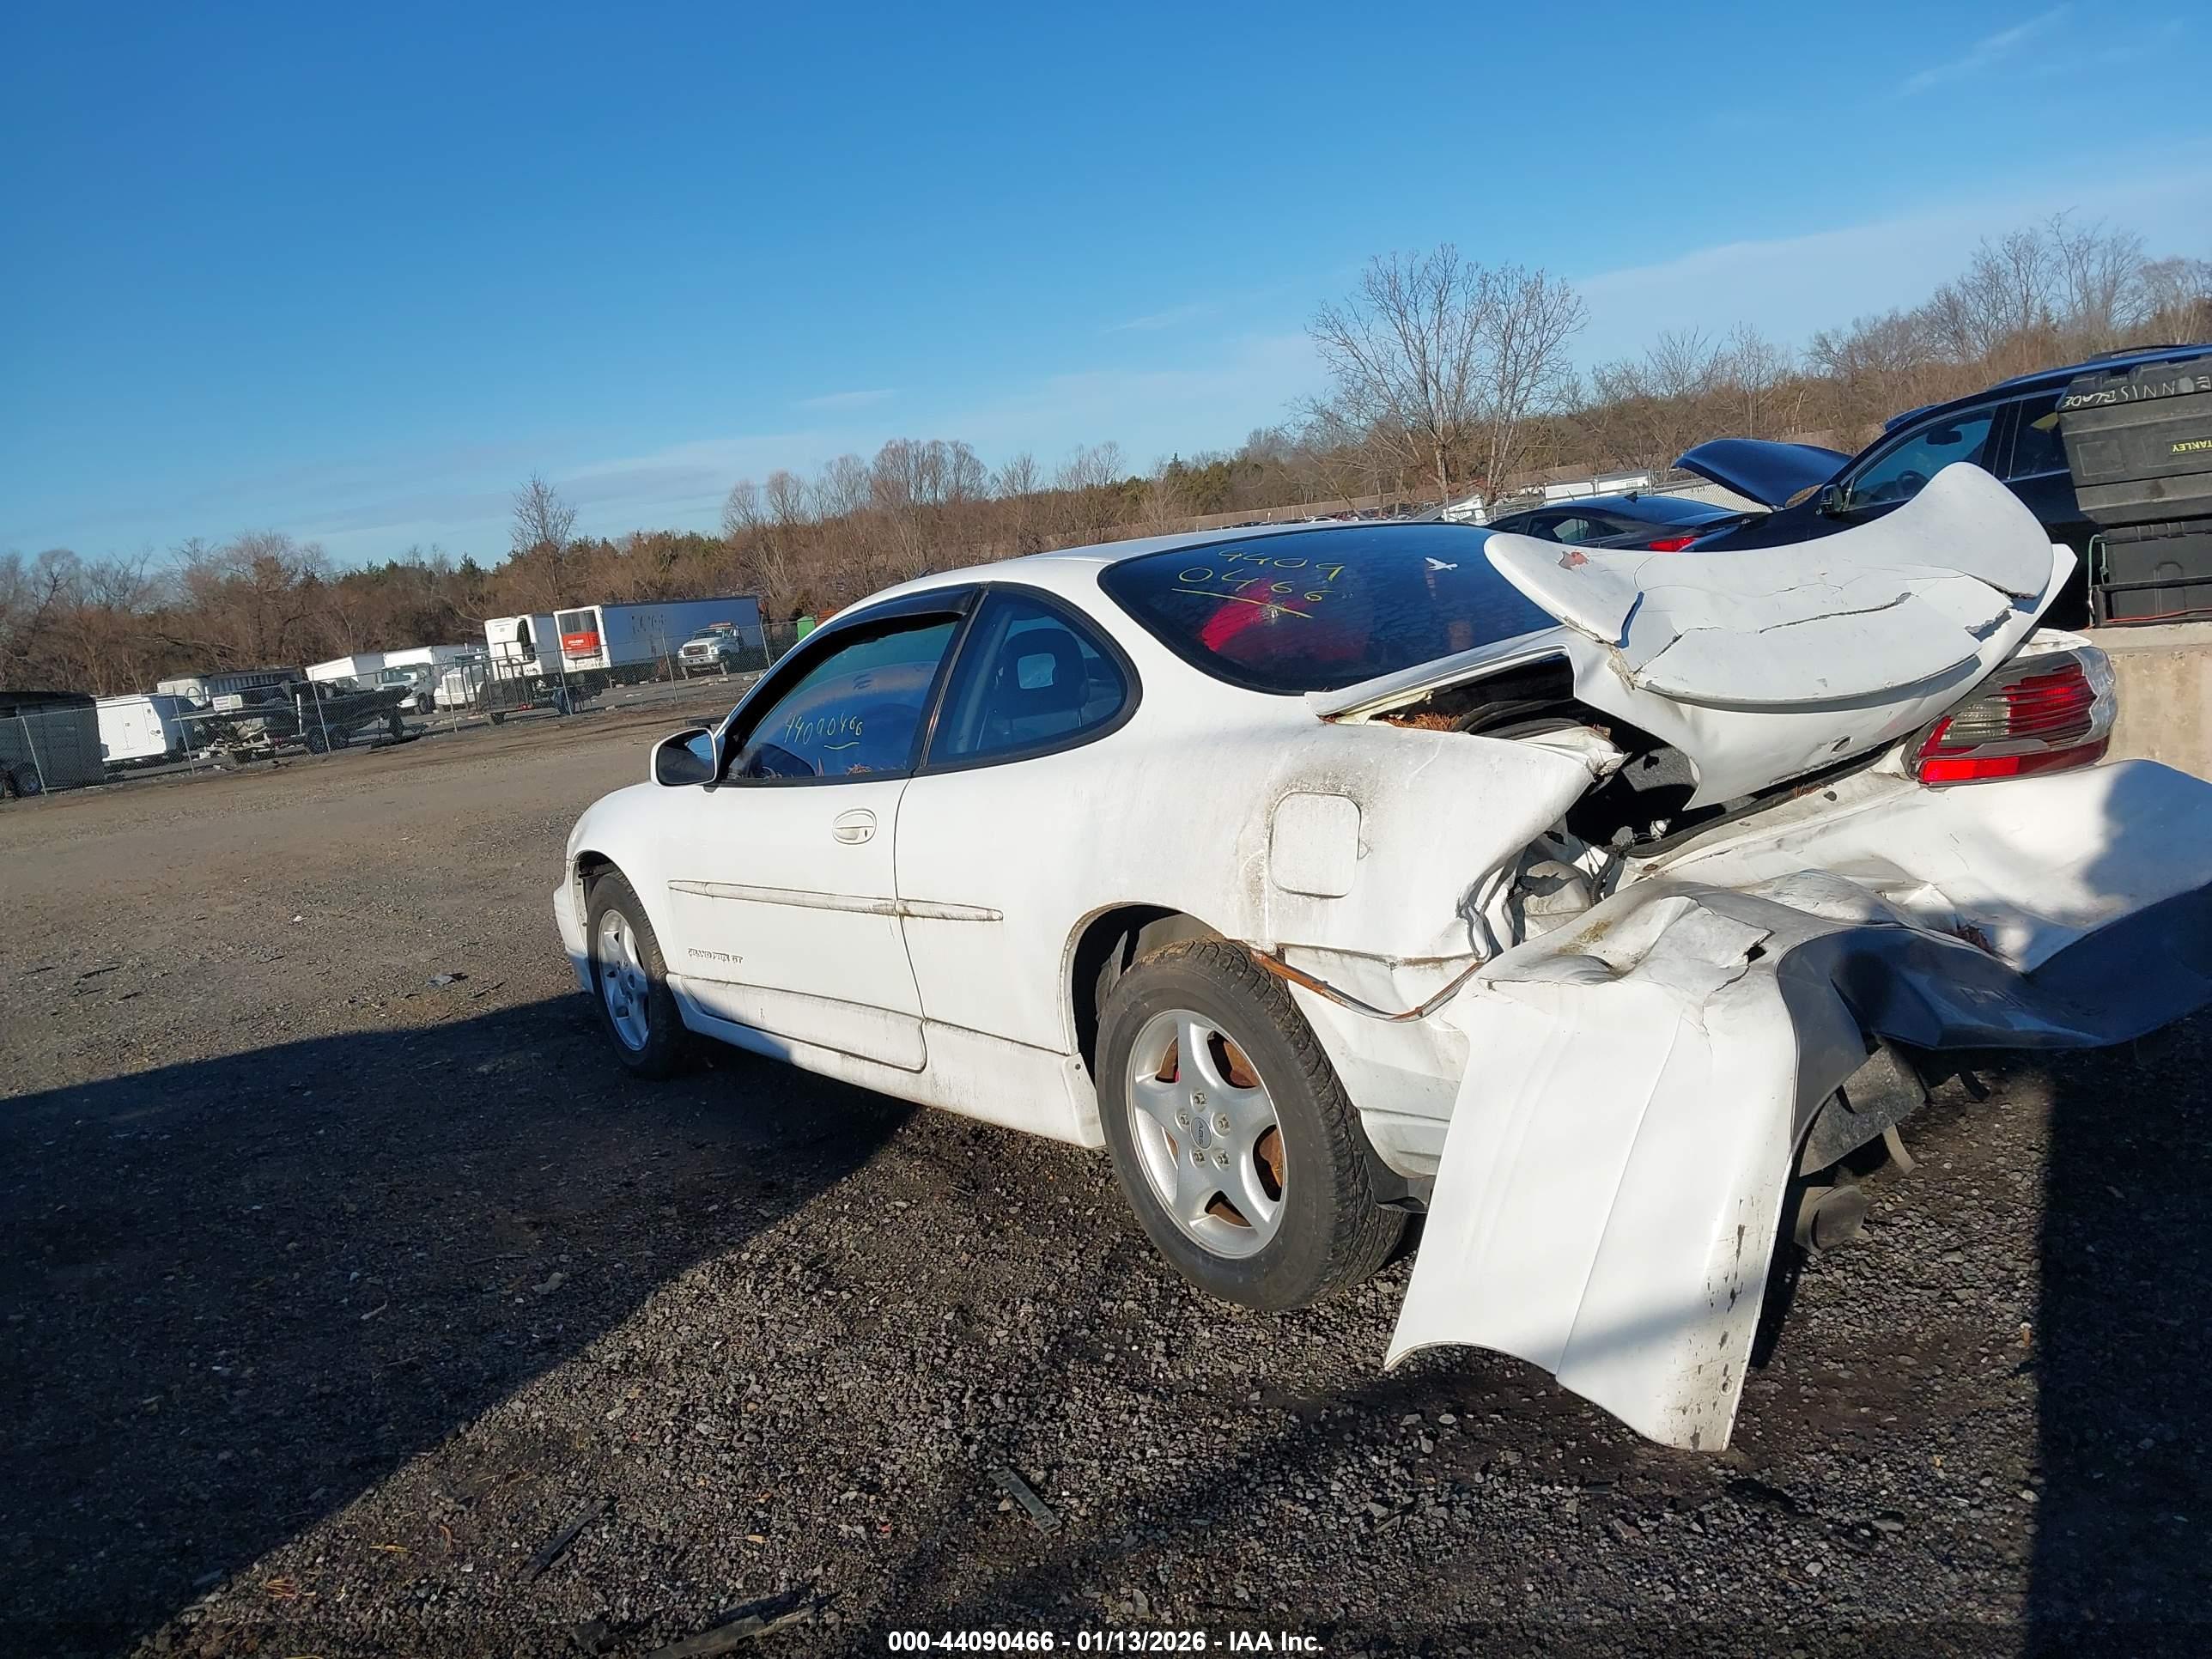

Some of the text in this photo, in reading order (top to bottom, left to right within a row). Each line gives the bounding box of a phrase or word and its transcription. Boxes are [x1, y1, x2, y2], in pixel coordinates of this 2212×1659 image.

[1217, 547, 1346, 582] 4409
[1178, 567, 1336, 602] 0466
[783, 712, 864, 745] 44090466
[687, 948, 712, 958] GRAND
